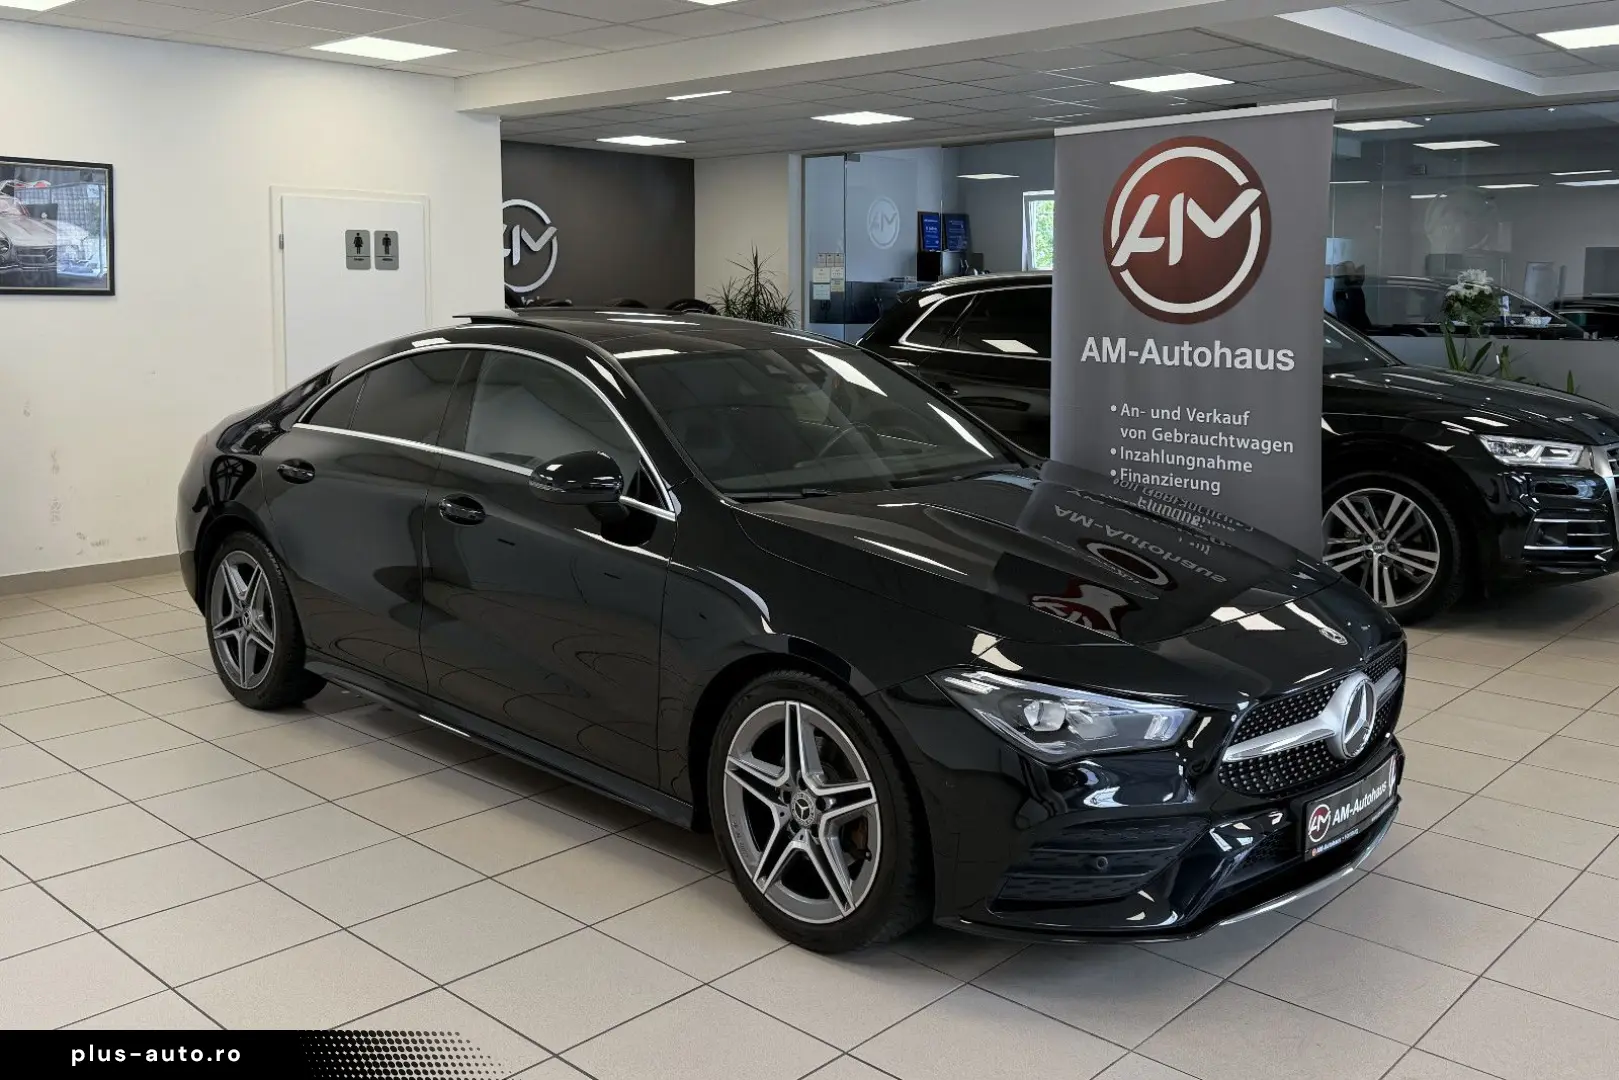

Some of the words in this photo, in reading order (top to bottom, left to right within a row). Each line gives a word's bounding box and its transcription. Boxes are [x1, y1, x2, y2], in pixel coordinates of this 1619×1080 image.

[1111, 188, 1262, 268] AM
[1080, 336, 1296, 371] AM-Autohaus
[1120, 403, 1147, 418] An-
[1150, 406, 1181, 421] und
[1186, 407, 1251, 426] Verkauf
[1120, 427, 1147, 440] von
[1151, 427, 1294, 455] Gebrauchtwagen
[1120, 446, 1253, 473] Inzahlungnahme
[1120, 467, 1221, 496] Finanzierung
[1331, 780, 1387, 826] AM-Autohaus
